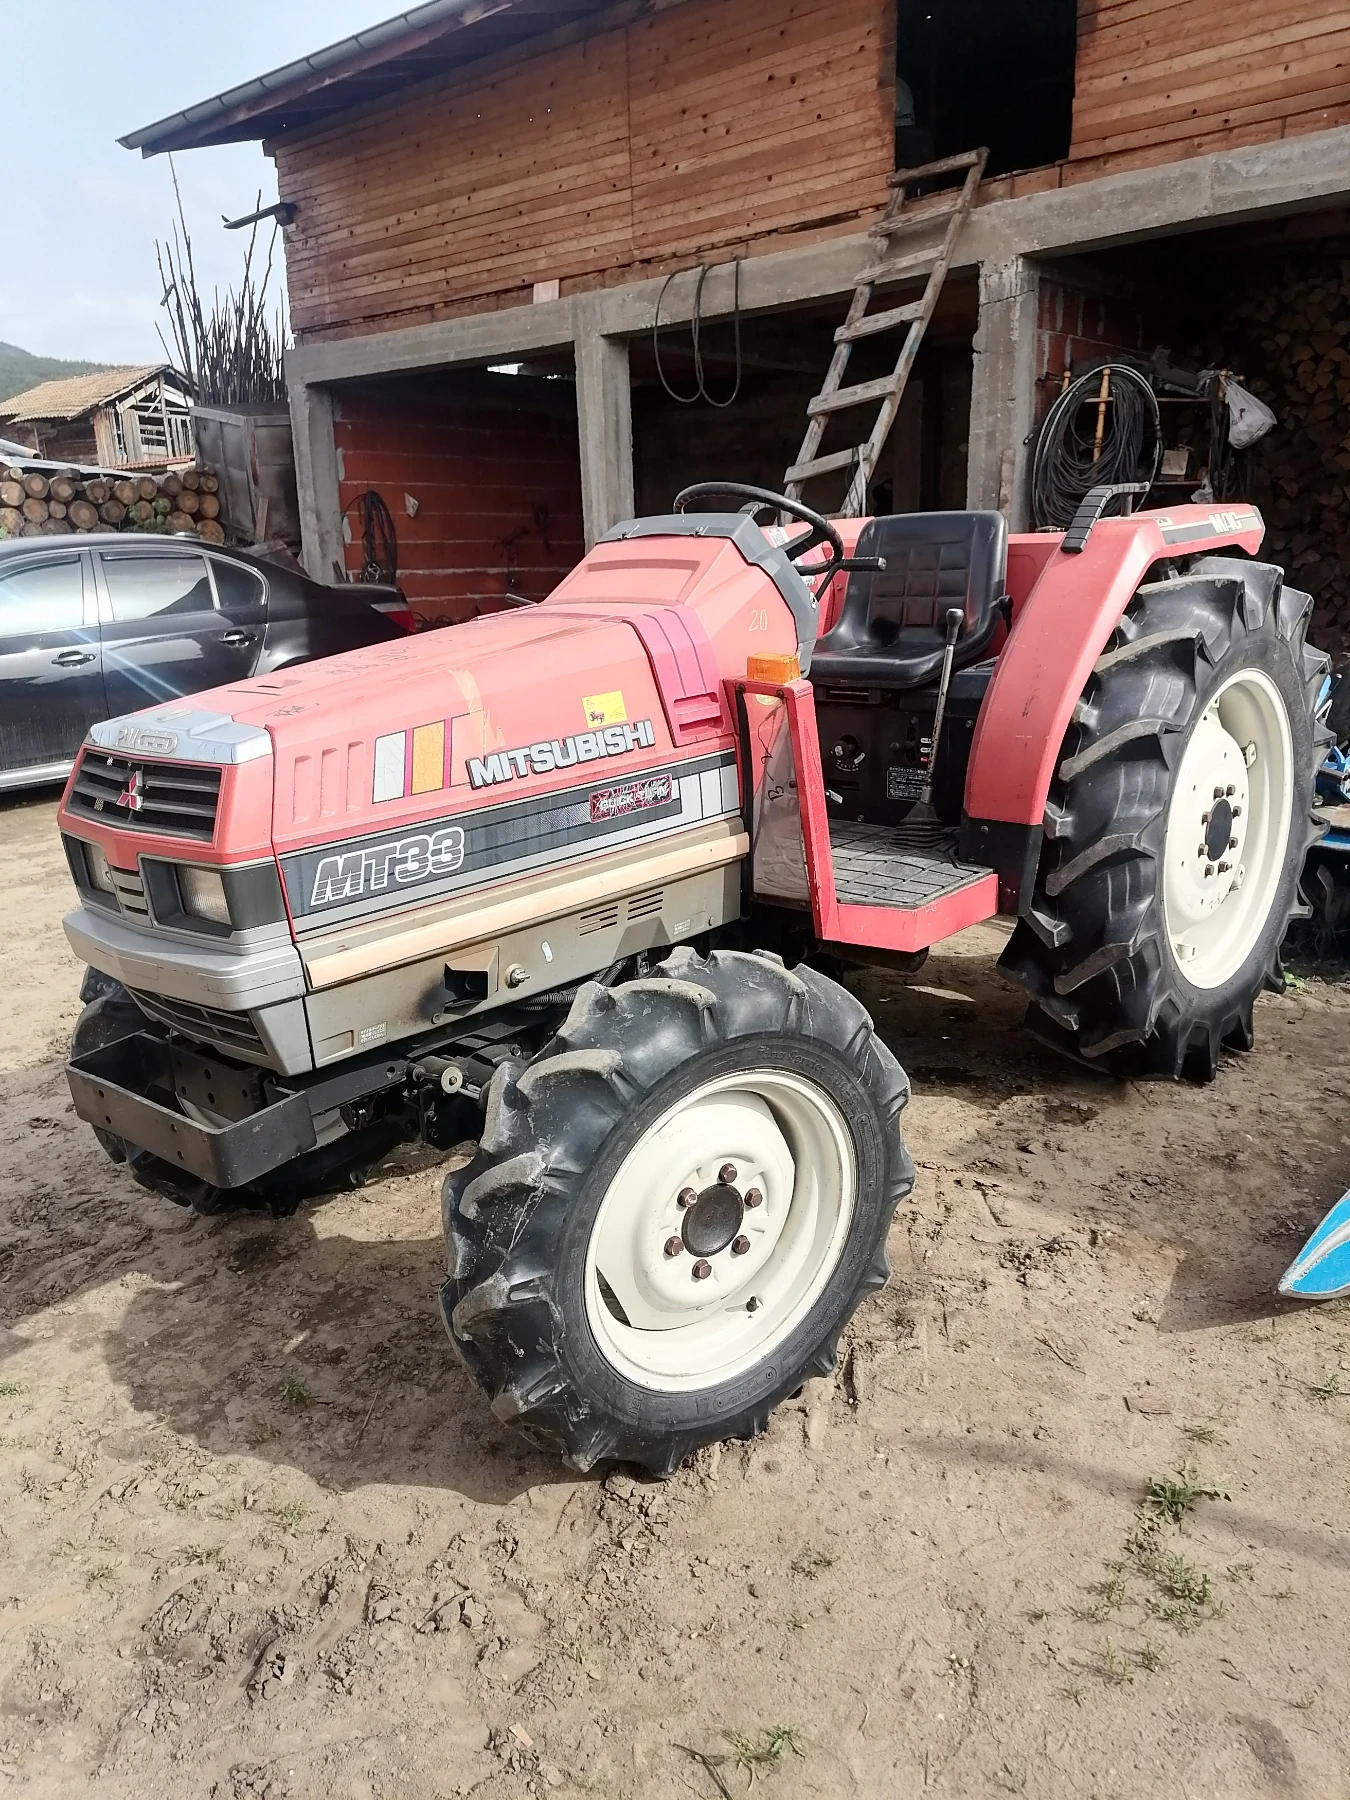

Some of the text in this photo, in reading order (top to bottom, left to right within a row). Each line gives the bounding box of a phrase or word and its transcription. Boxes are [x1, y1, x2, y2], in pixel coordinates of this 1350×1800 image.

[749, 609, 768, 632] 20
[468, 719, 656, 789] MITSUBISHI
[310, 826, 465, 906] MT33
